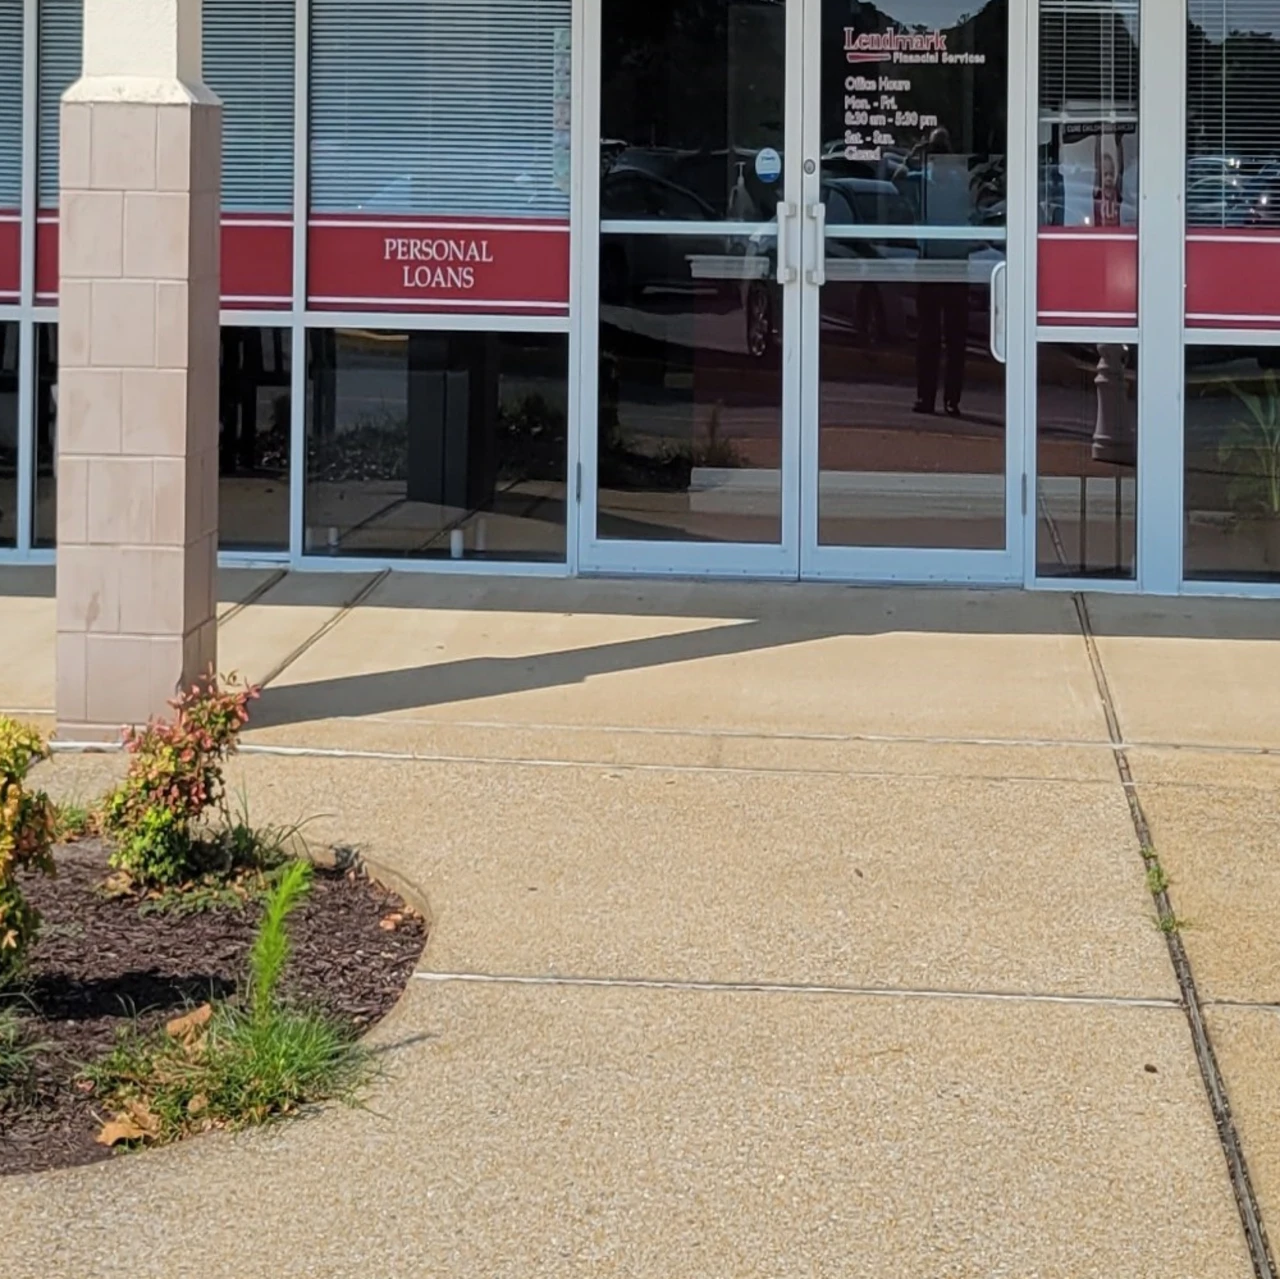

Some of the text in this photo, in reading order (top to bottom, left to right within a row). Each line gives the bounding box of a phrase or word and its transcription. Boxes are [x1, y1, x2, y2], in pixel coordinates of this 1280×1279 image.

[843, 26, 947, 50] Lendmark
[892, 52, 986, 64] Financial Services
[844, 76, 911, 91] Office Hours
[844, 95, 871, 110] Mon.
[919, 114, 938, 130] pm
[383, 238, 494, 263] PERSONAL
[402, 266, 475, 289] LOANS
